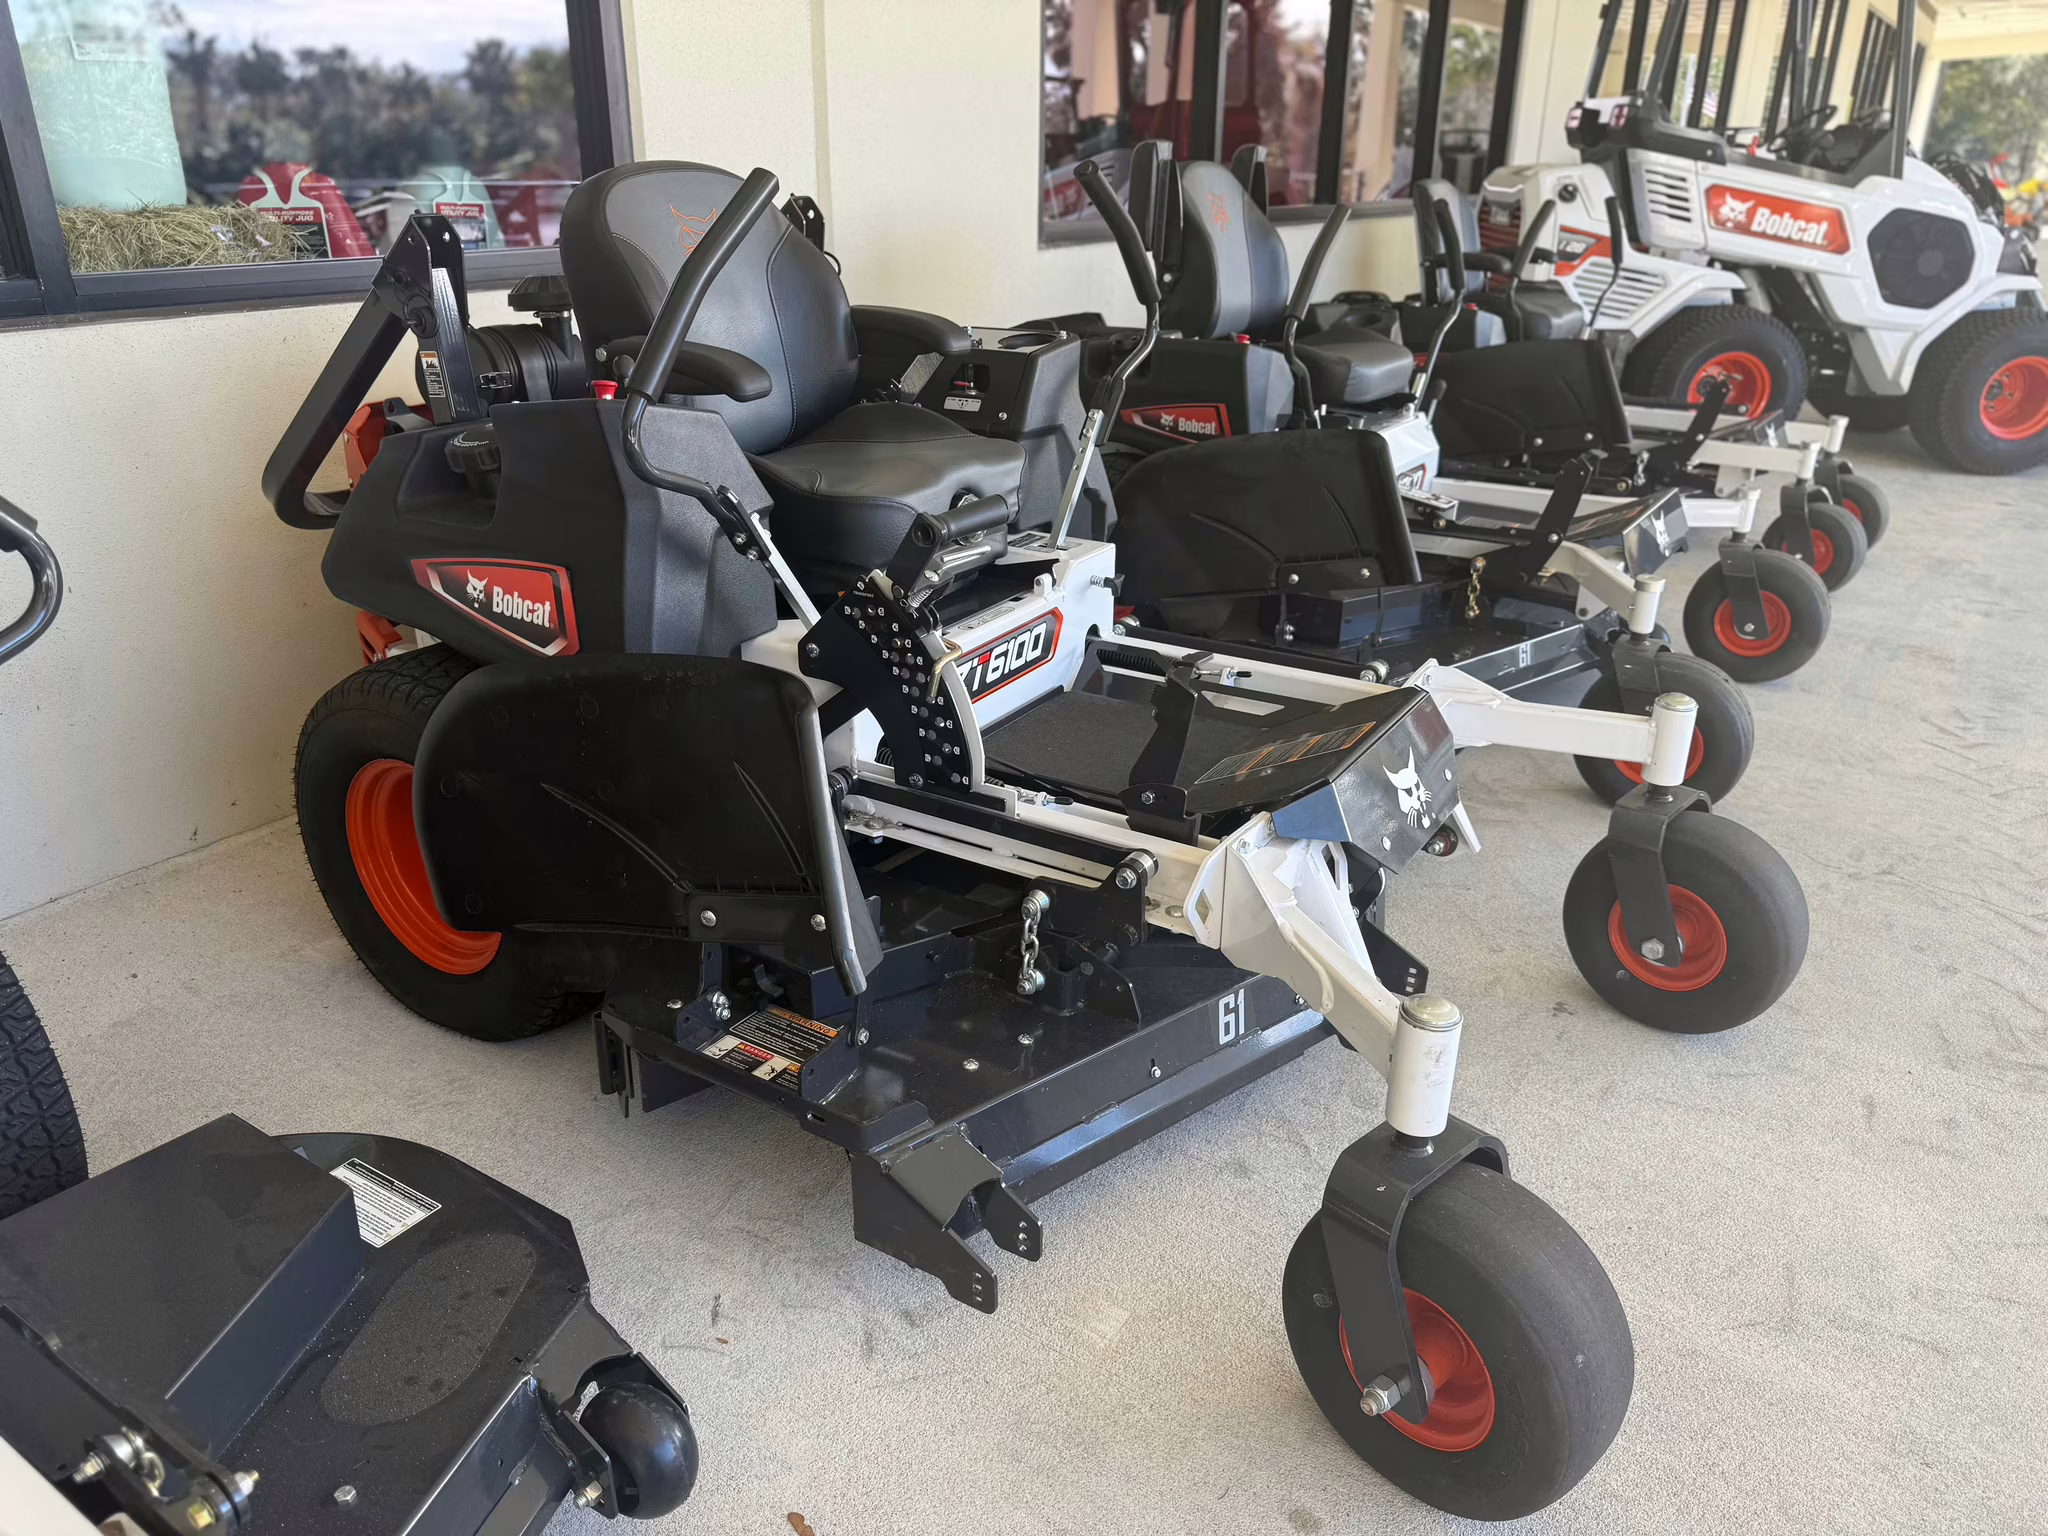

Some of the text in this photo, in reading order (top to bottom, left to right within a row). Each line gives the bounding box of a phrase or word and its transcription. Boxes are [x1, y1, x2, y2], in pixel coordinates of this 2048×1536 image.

[1750, 206, 1828, 245] Bobcat
[1178, 417, 1216, 435] Bobcat
[853, 590, 874, 598] TRANSPORT
[492, 585, 551, 628] Bobcat
[1519, 642, 1531, 668] 61
[788, 1014, 831, 1034] WARNING
[1218, 988, 1245, 1045] 61
[745, 1044, 772, 1060] DANGER
